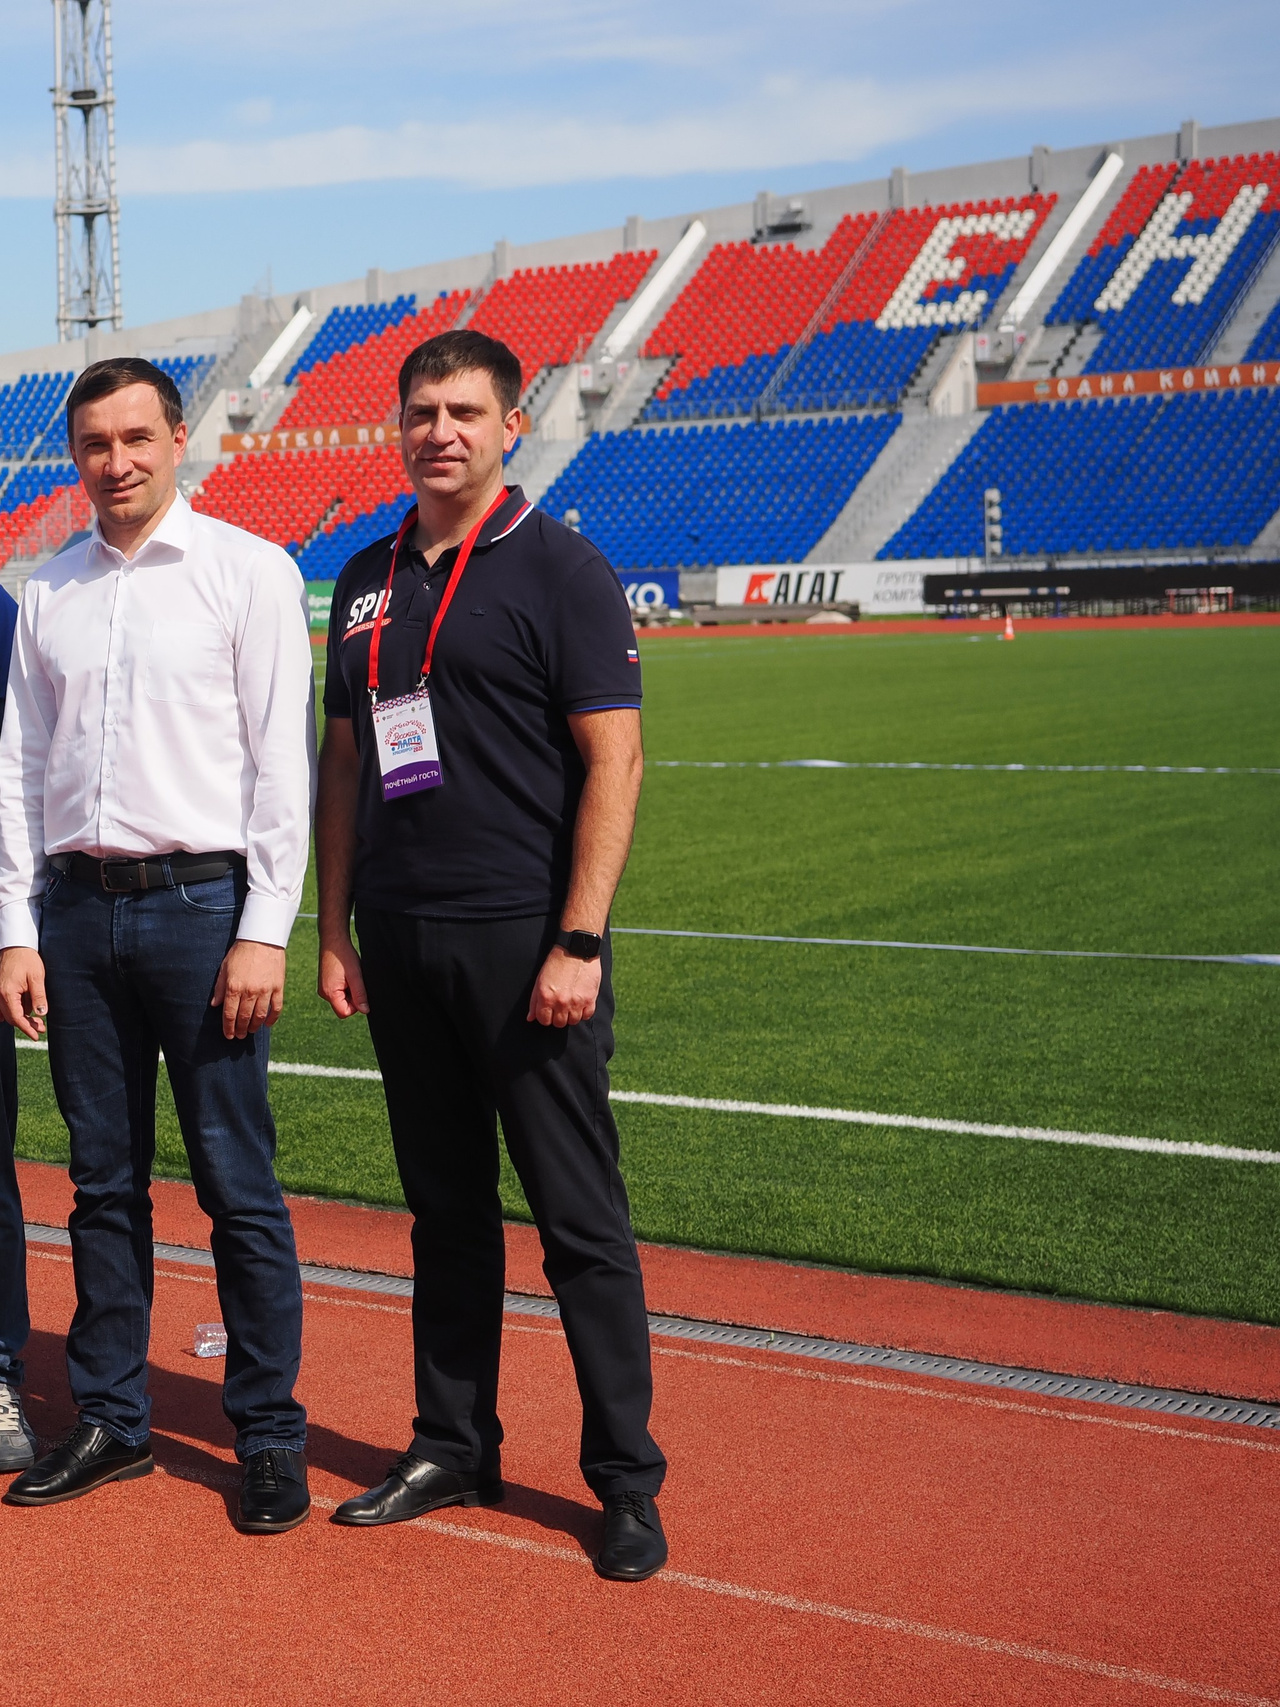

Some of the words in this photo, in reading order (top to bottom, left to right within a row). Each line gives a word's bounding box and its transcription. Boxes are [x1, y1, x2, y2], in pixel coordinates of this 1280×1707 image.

[1158, 362, 1280, 390] КОМАН
[240, 428, 340, 450] ФУТБОЛ
[774, 570, 845, 604] АГАТ
[876, 571, 924, 585] ГРУПП
[418, 770, 439, 781] ГОСТЬ
